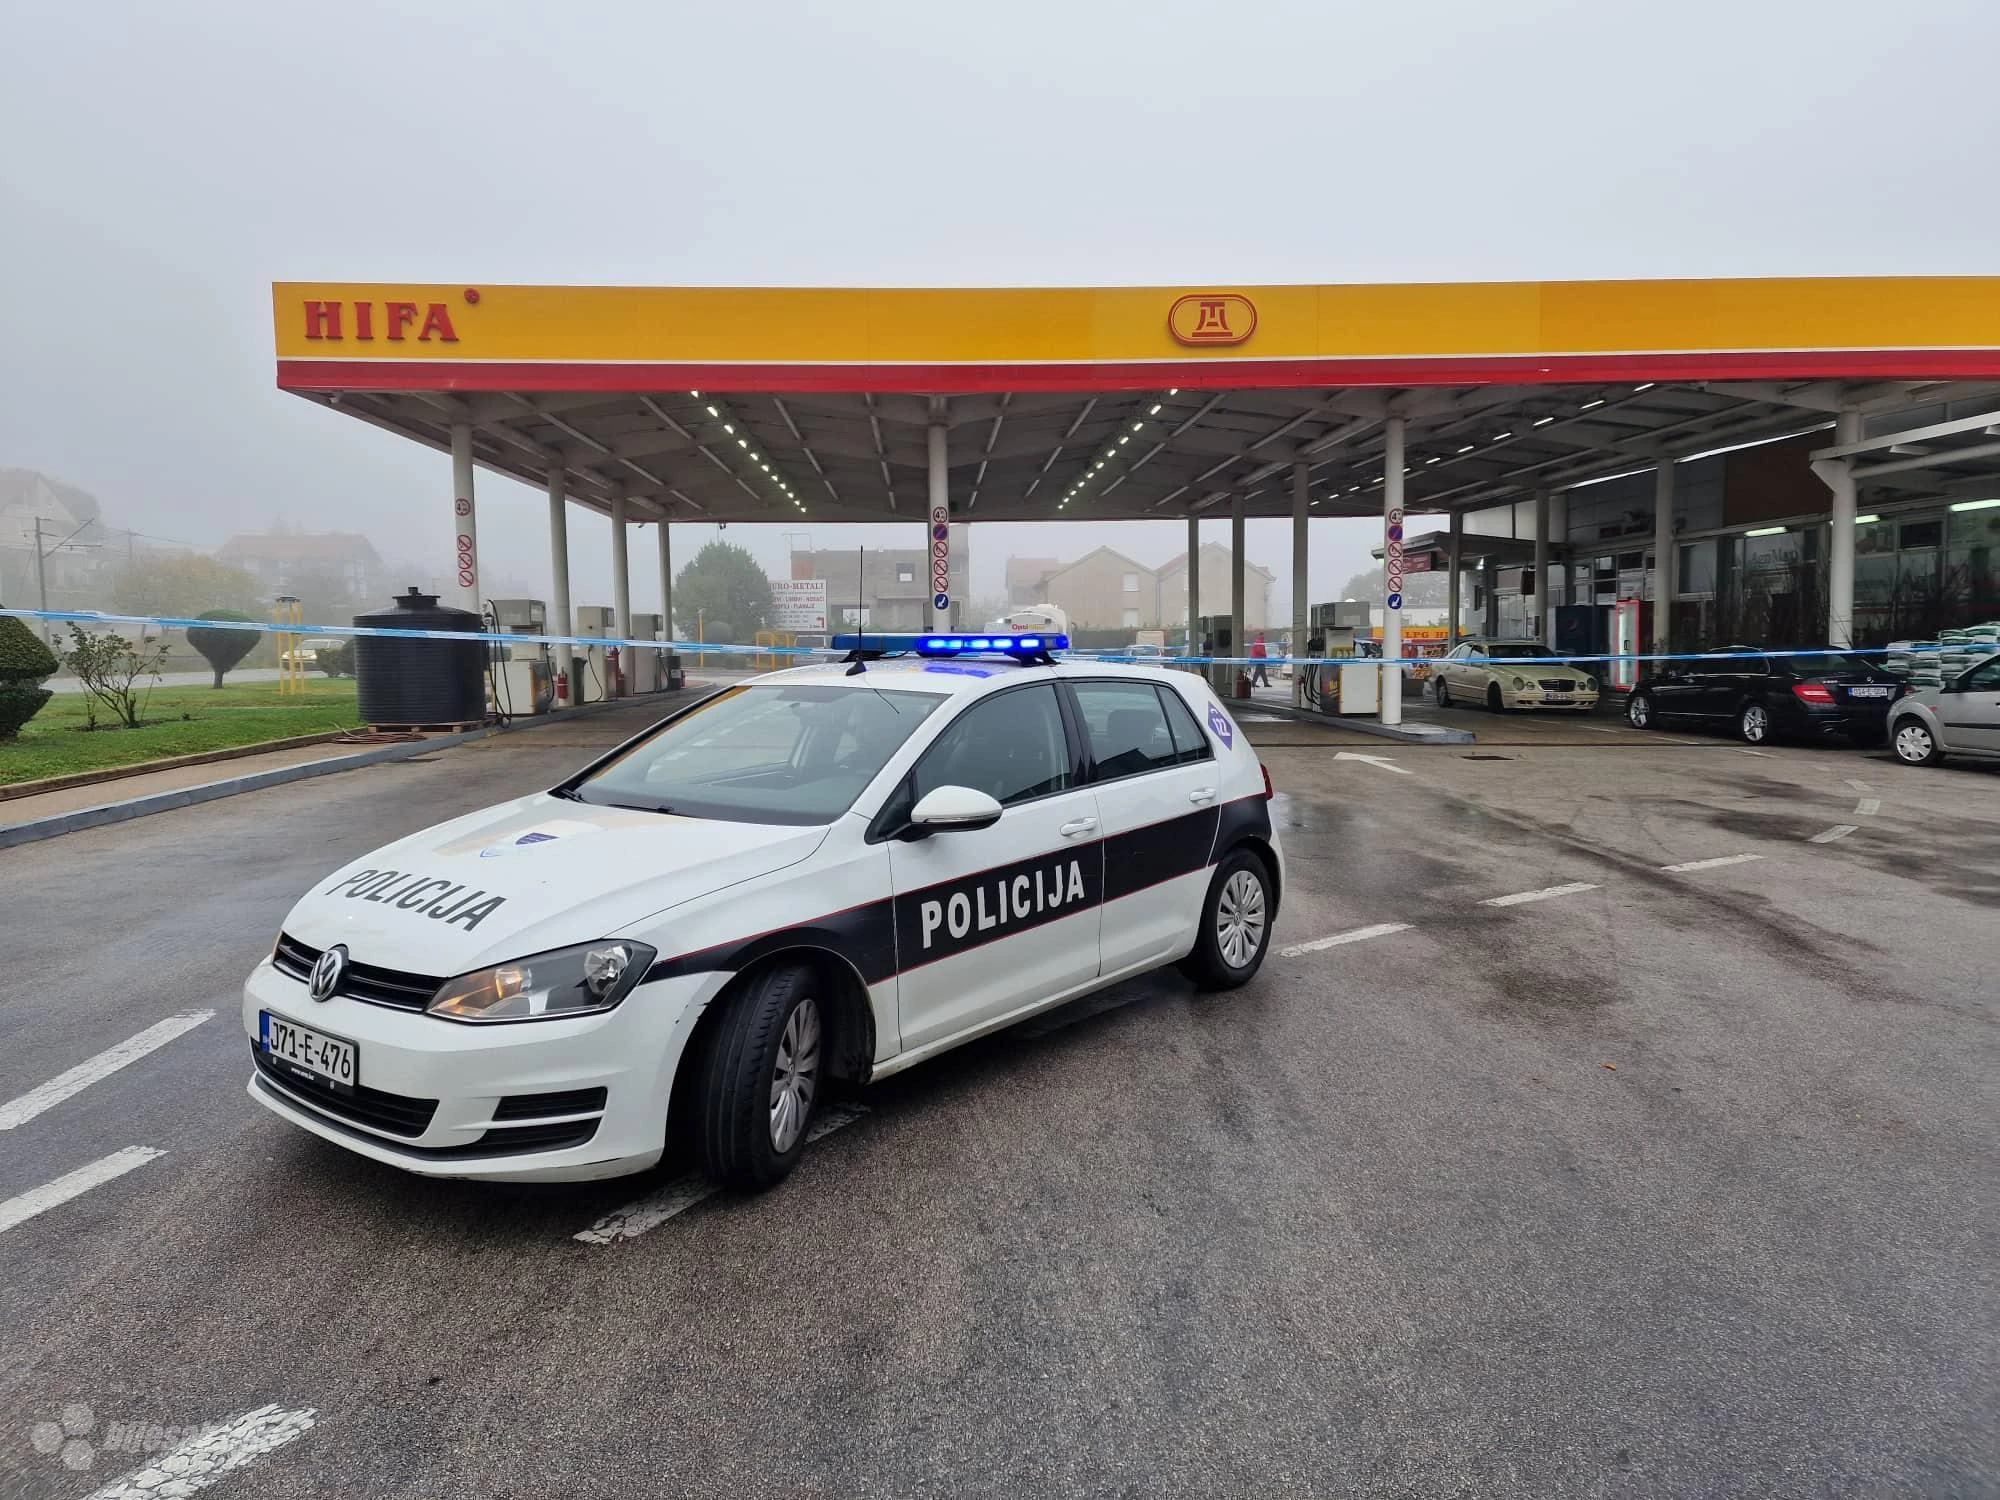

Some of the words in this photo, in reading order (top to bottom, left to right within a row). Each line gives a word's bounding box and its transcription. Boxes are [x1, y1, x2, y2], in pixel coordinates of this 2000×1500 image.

[303, 301, 460, 341] HIFA
[1405, 631, 1429, 639] LPG
[1212, 718, 1231, 737] 122
[325, 869, 507, 932] POLICIJA
[921, 860, 1085, 949] POLICIJA
[270, 1021, 351, 1079] J71-E-476
